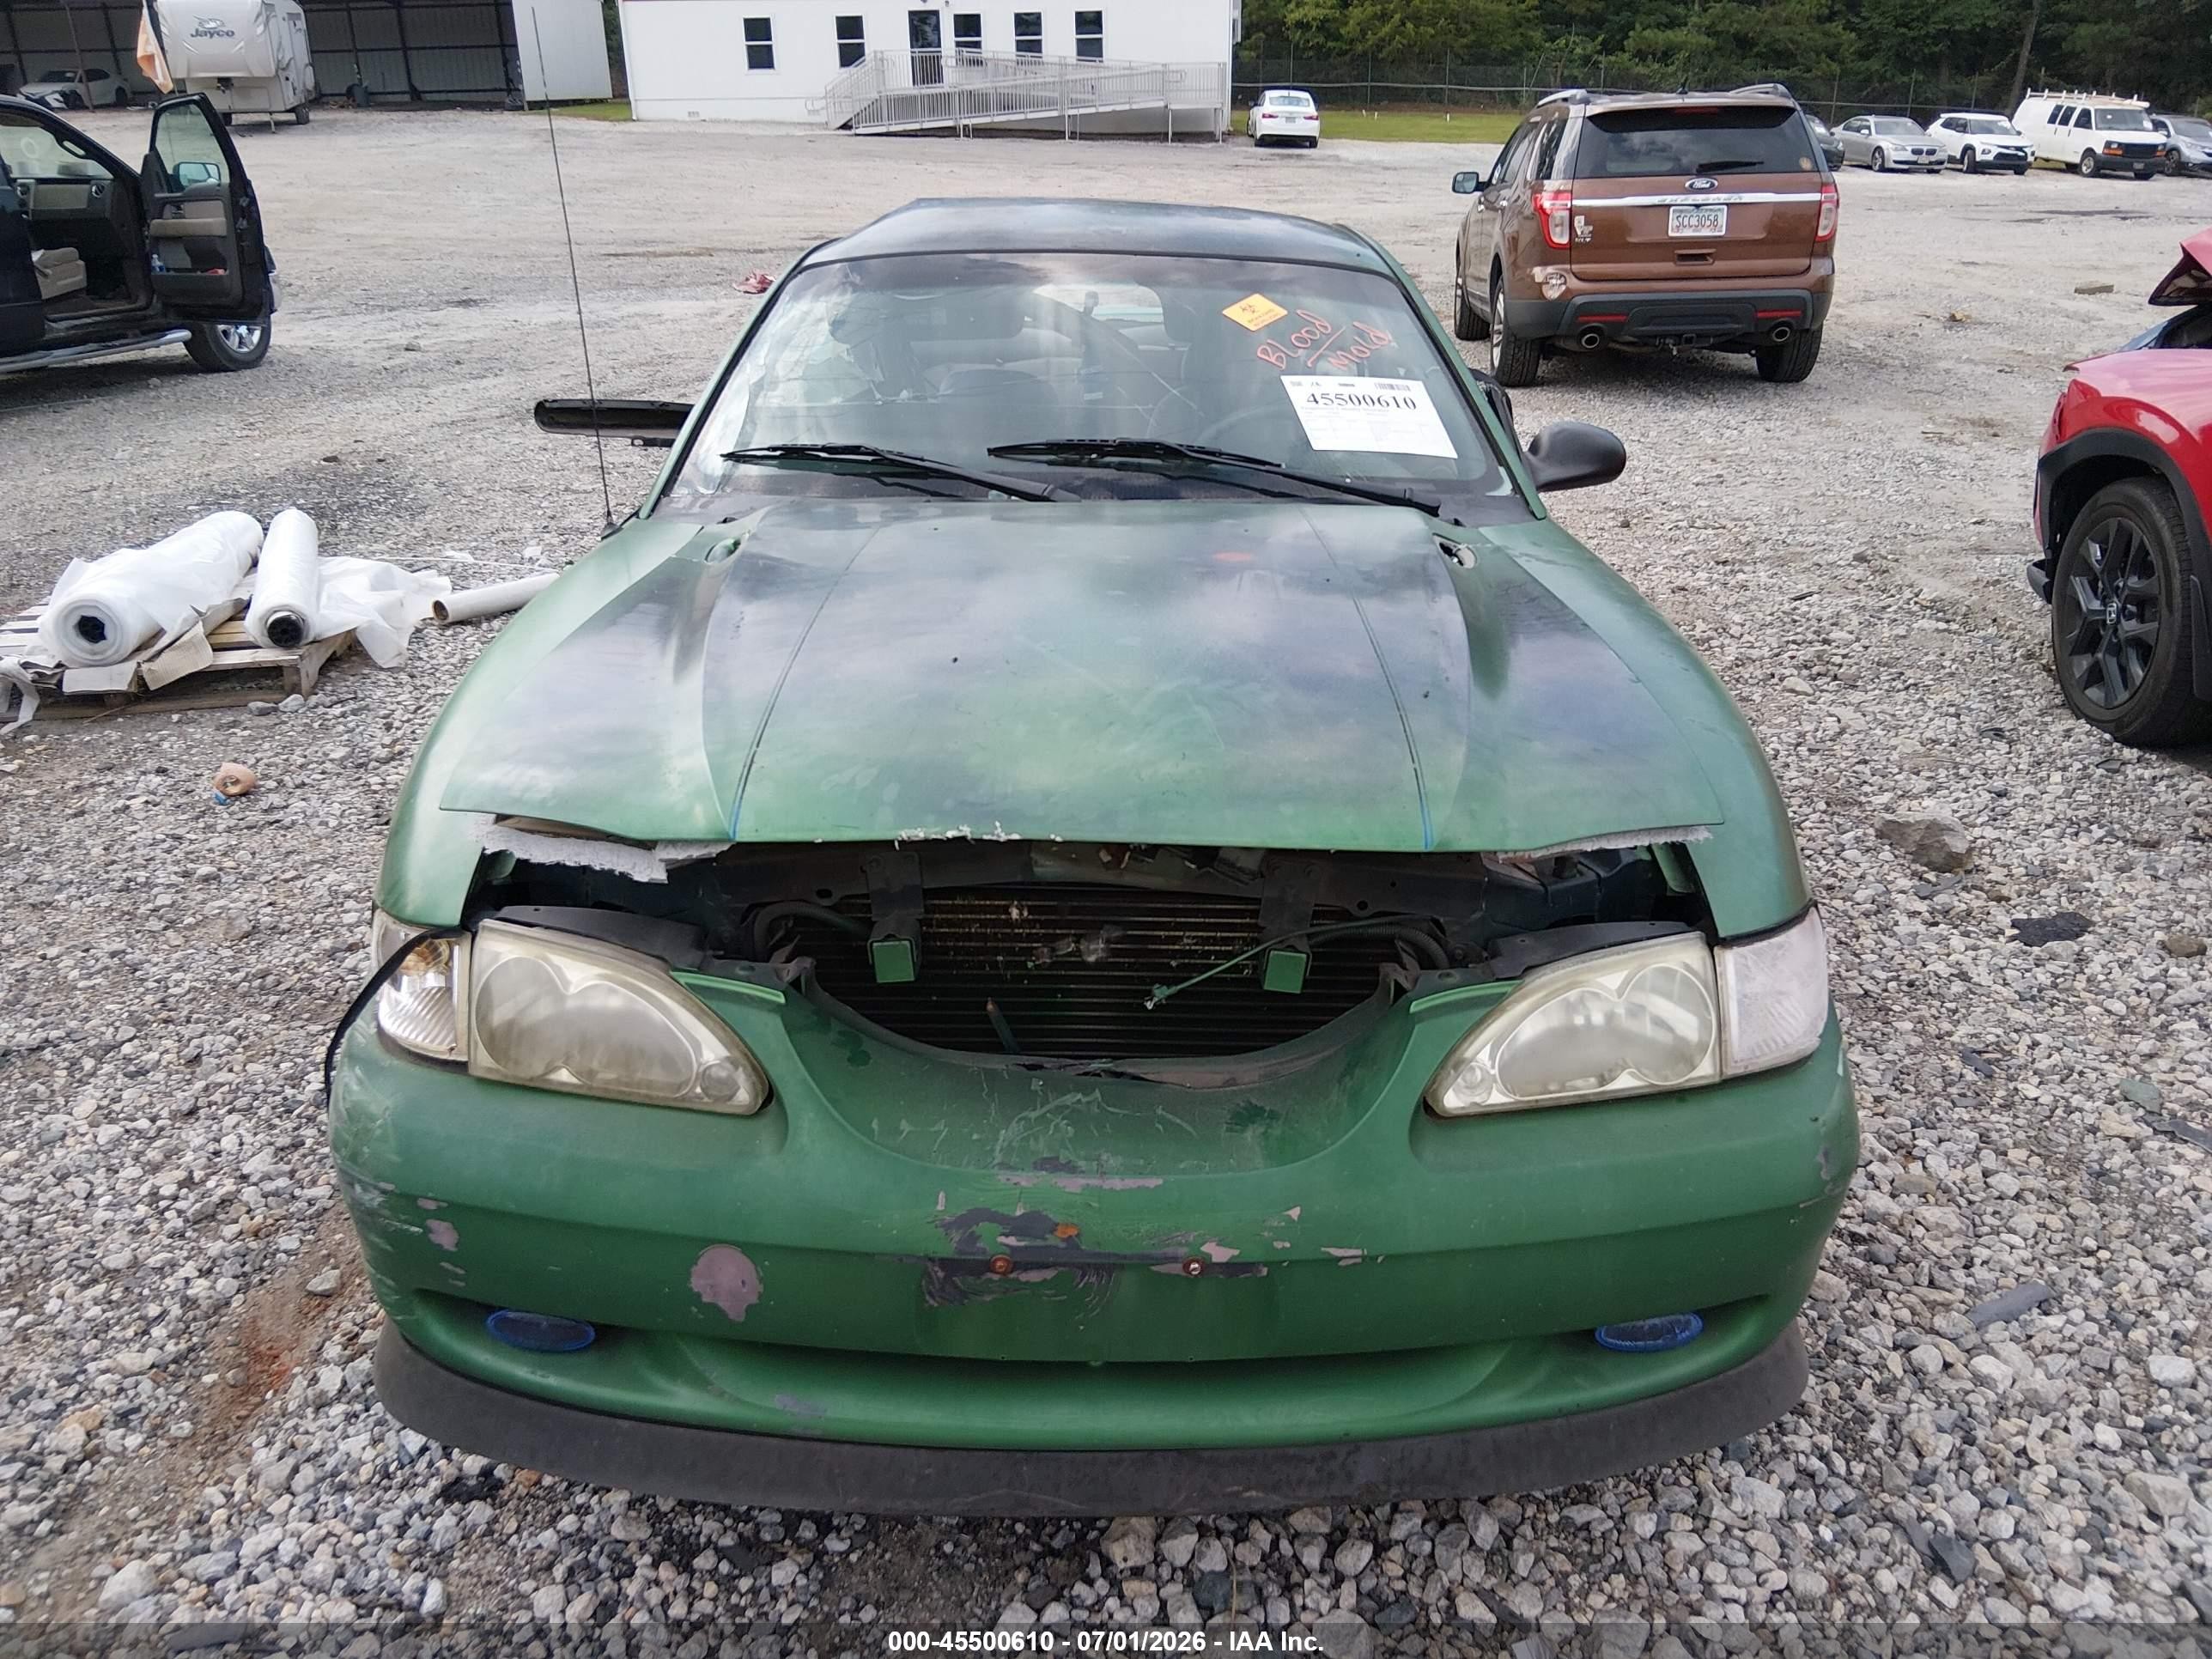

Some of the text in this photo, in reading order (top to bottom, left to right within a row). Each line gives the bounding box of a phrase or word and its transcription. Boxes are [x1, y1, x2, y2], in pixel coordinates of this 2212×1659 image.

[190, 28, 235, 39] Jayco
[1675, 214, 1719, 228] SCC3058
[1306, 392, 1417, 410] 45500610
